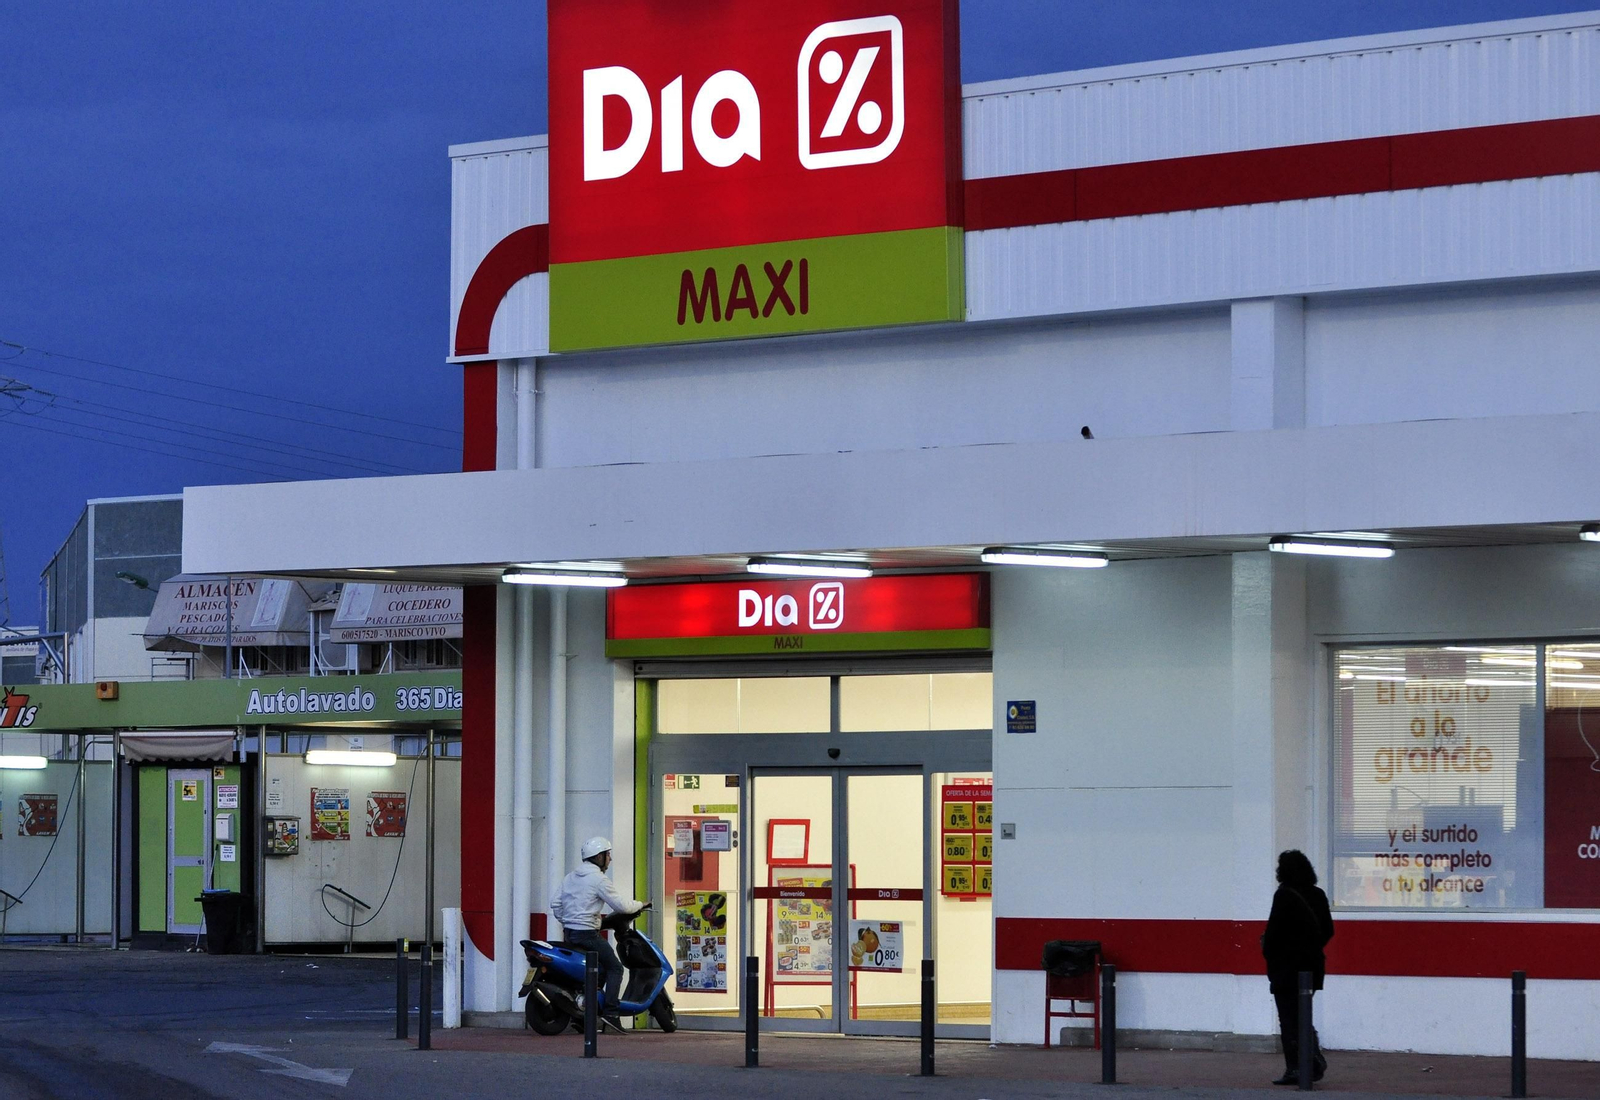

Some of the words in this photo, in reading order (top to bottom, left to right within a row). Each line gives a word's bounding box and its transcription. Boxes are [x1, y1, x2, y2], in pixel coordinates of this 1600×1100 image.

[677, 258, 808, 325] MAXI
[388, 599, 451, 611] COCEDERO
[175, 624, 240, 634] CARACOLS
[365, 617, 388, 625] PARA
[342, 630, 379, 639] 600517520
[385, 628, 424, 638] MARISCO
[425, 627, 446, 637] VIVO
[774, 636, 803, 649] MAXI
[246, 685, 376, 714] Autolavado
[395, 686, 432, 710] 365
[1410, 717, 1426, 738] a
[1435, 709, 1456, 738] lo
[1374, 735, 1493, 784] grande
[1388, 829, 1398, 848] y
[1402, 824, 1416, 842] el
[1421, 824, 1478, 842] surtido
[1375, 848, 1410, 867] más
[1414, 849, 1492, 872] completo
[1578, 843, 1600, 859] CO
[1382, 878, 1392, 892] a
[1398, 875, 1414, 892] tu
[1420, 873, 1484, 892] alcance
